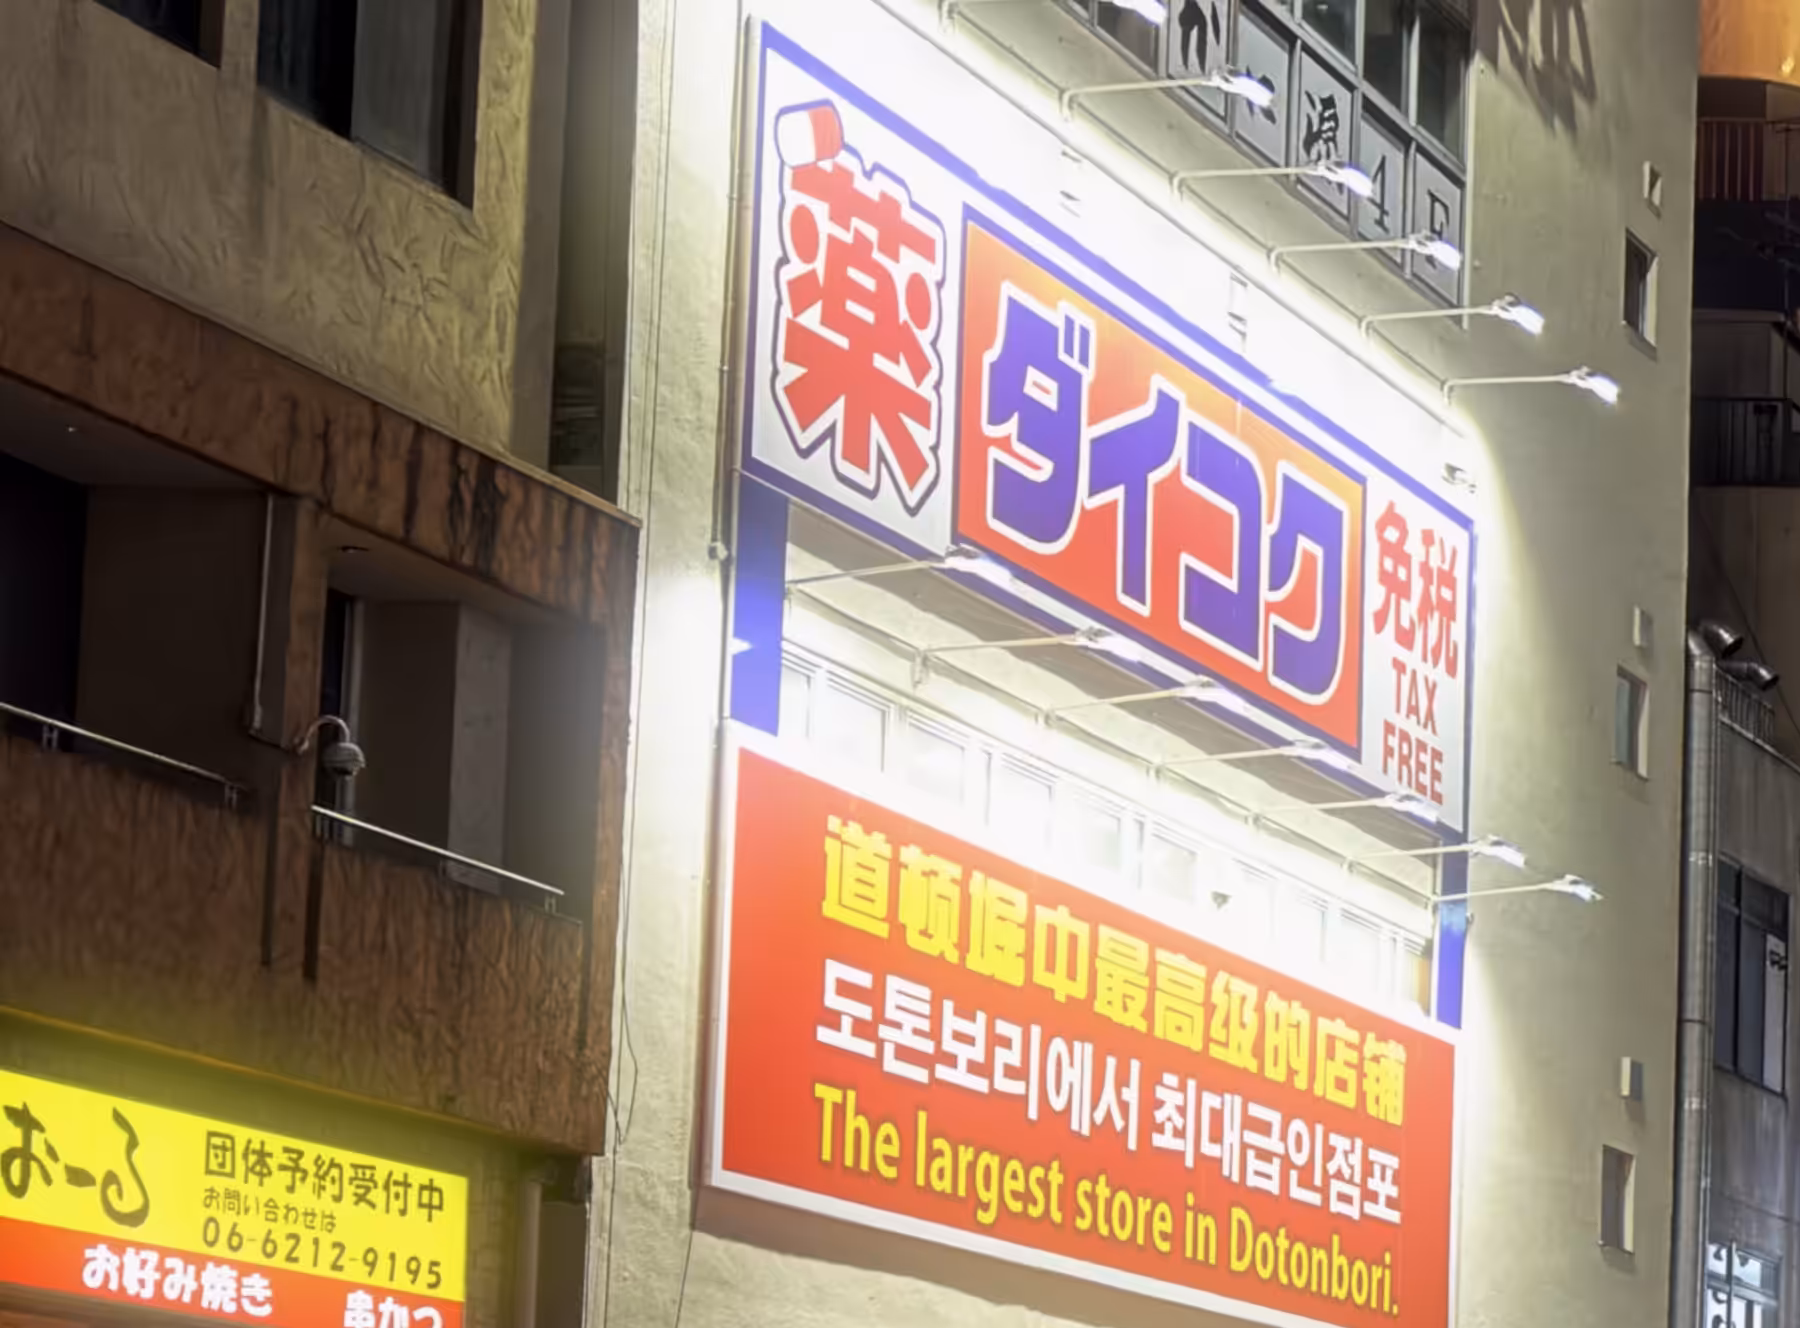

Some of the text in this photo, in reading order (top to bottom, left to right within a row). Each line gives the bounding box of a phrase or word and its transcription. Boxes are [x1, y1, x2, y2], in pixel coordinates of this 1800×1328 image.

[782, 160, 936, 494] 薬
[984, 286, 1347, 702] ダイコク
[1373, 500, 1459, 680] 免税
[1391, 655, 1438, 728] TAX
[1382, 719, 1444, 806] FREE
[815, 957, 1402, 1226] 도톤보리에서 최대급인점포
[203, 1186, 338, 1234] お問い合わせは
[204, 1130, 445, 1222] 団体予約受付中
[814, 1083, 1400, 1317] The largest store in Dotonbori.
[82, 1243, 273, 1318] お好み焼き
[201, 1216, 443, 1290] 06-6212-9195
